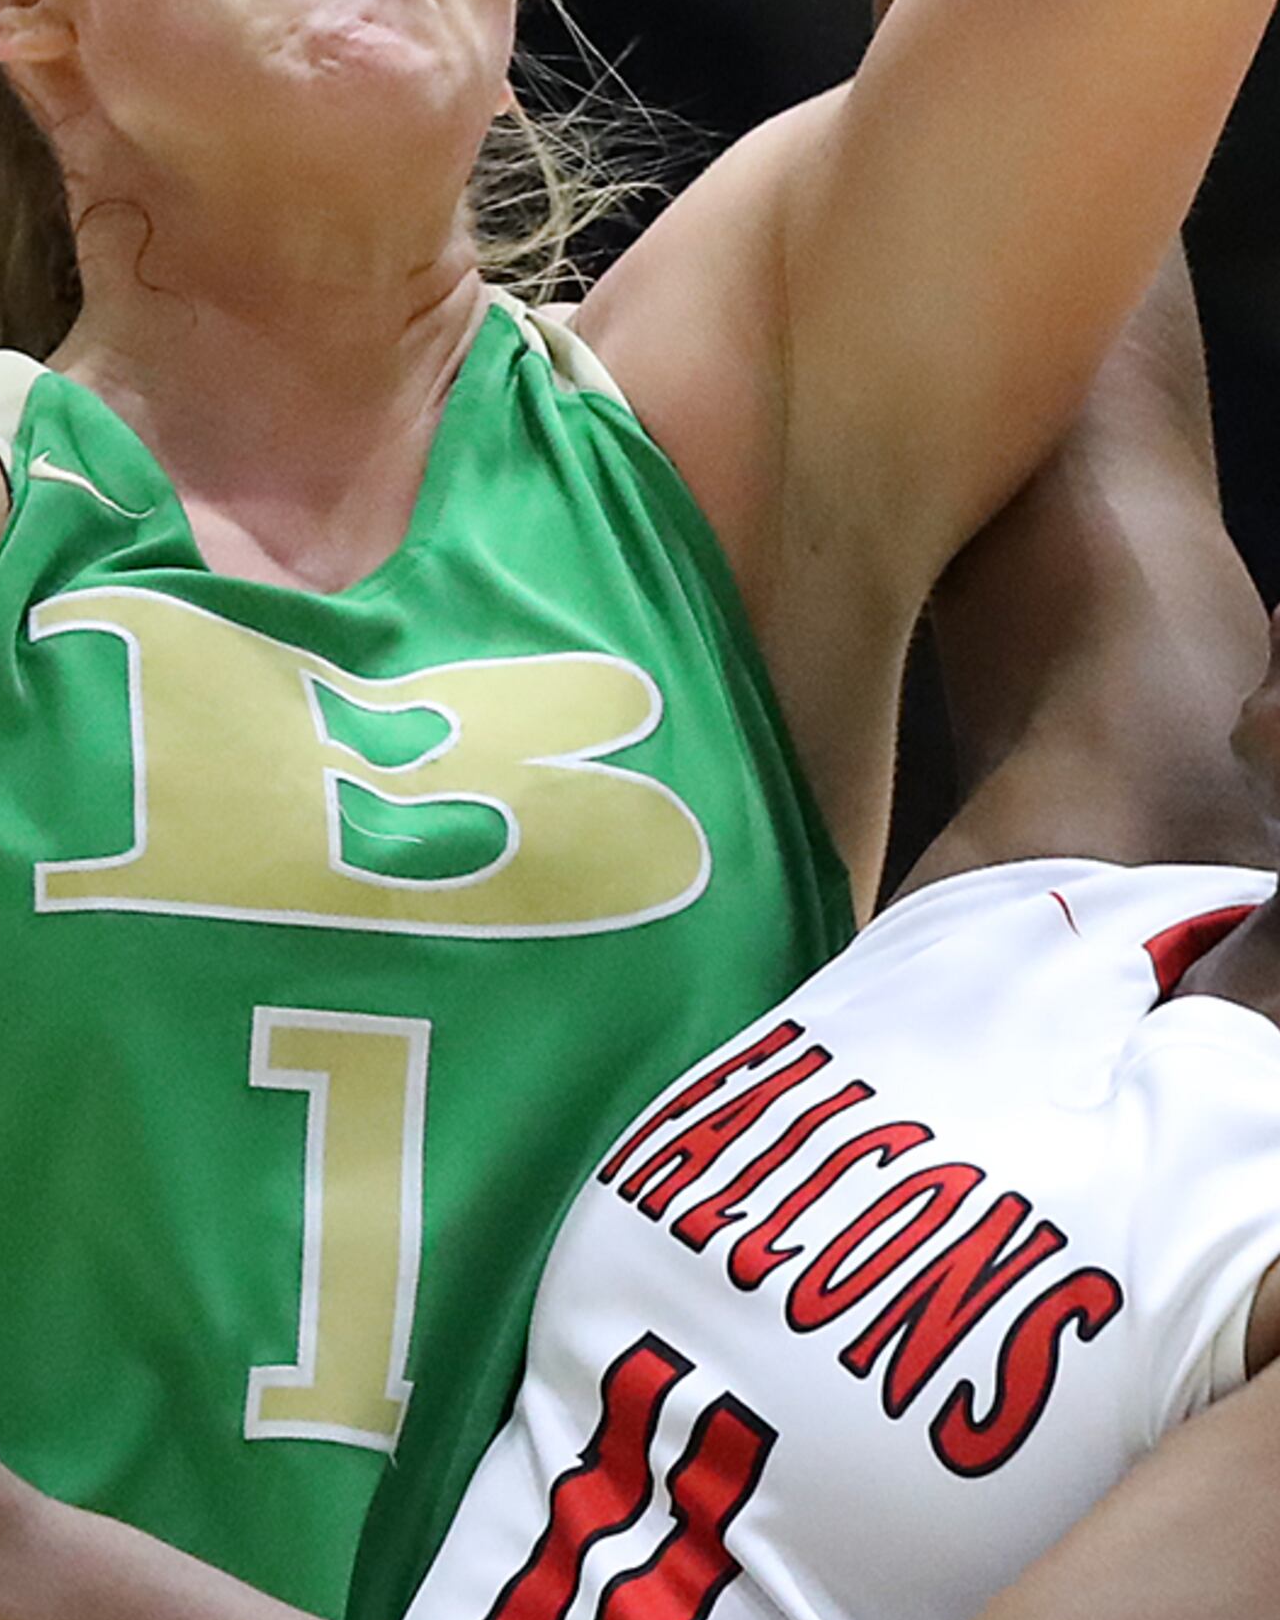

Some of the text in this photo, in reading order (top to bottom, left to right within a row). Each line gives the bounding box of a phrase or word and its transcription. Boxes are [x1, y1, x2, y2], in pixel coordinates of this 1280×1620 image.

[29, 586, 711, 940] B
[245, 1005, 432, 1454] 1
[596, 1019, 1124, 1479] FALCONS
